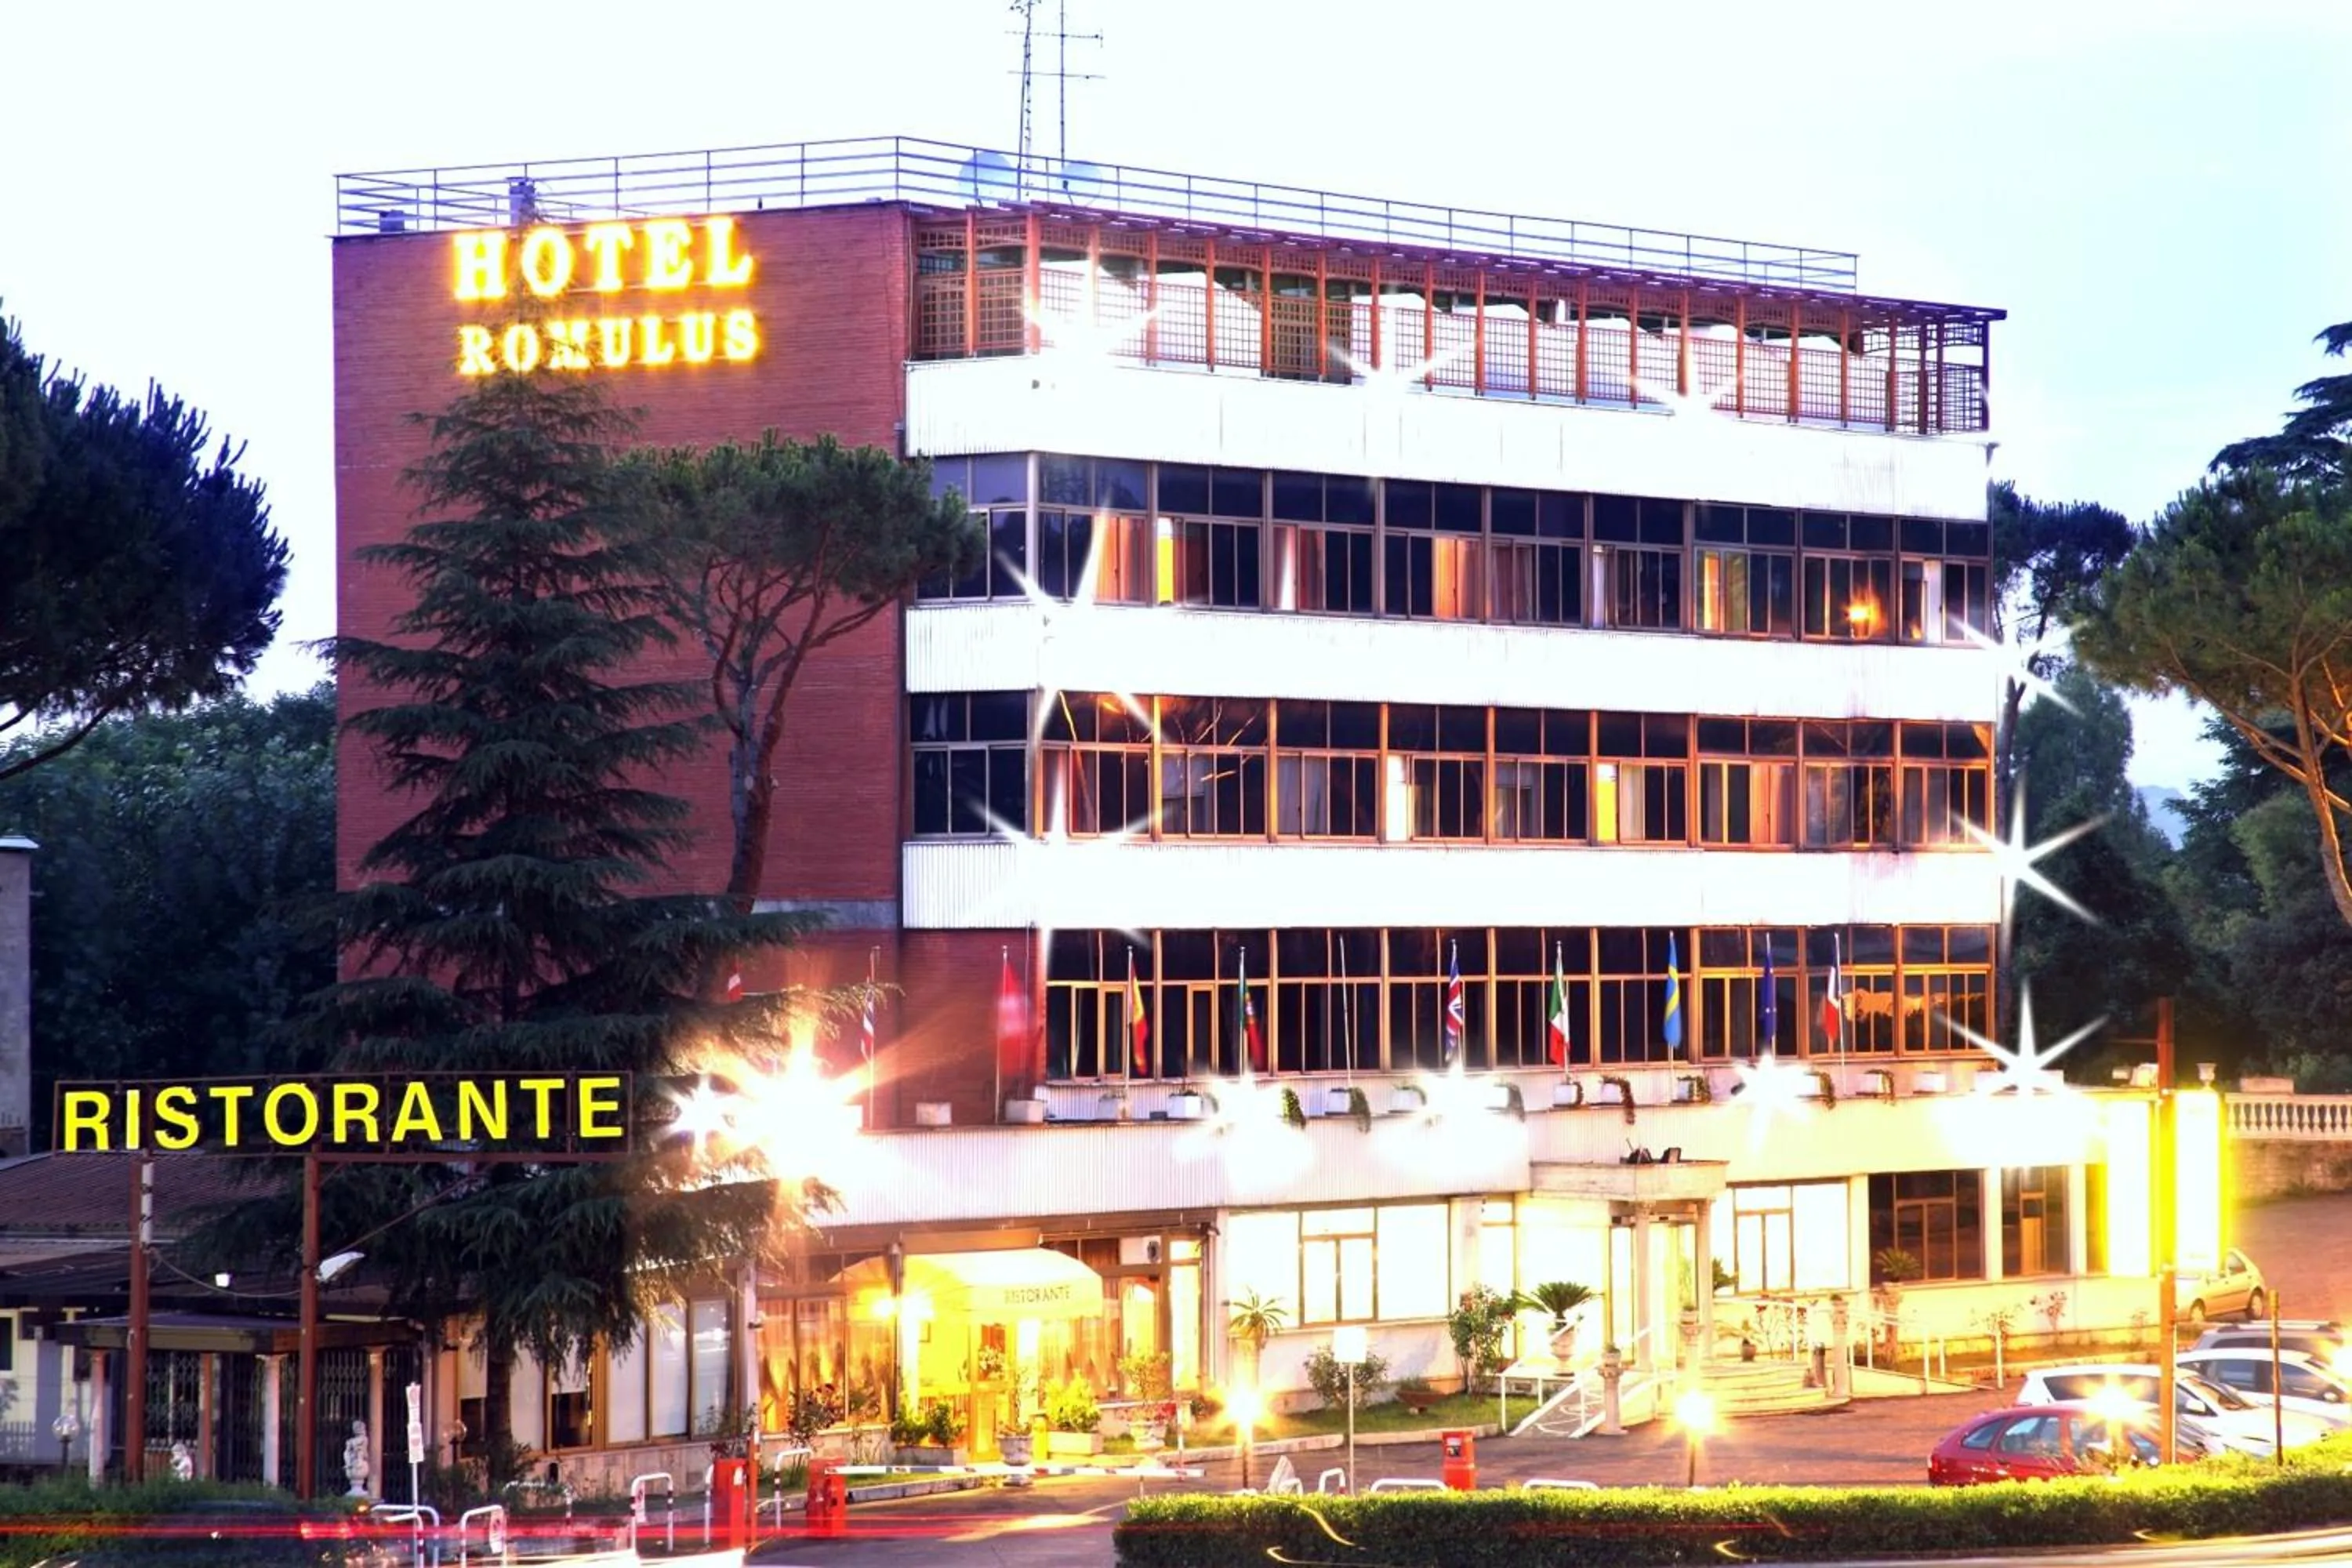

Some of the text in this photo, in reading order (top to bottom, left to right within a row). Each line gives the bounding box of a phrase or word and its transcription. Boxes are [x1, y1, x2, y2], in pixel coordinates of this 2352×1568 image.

[452, 216, 754, 300] HOTEL
[458, 309, 759, 376] ROMULUS
[64, 1076, 623, 1152] RISTORANTE
